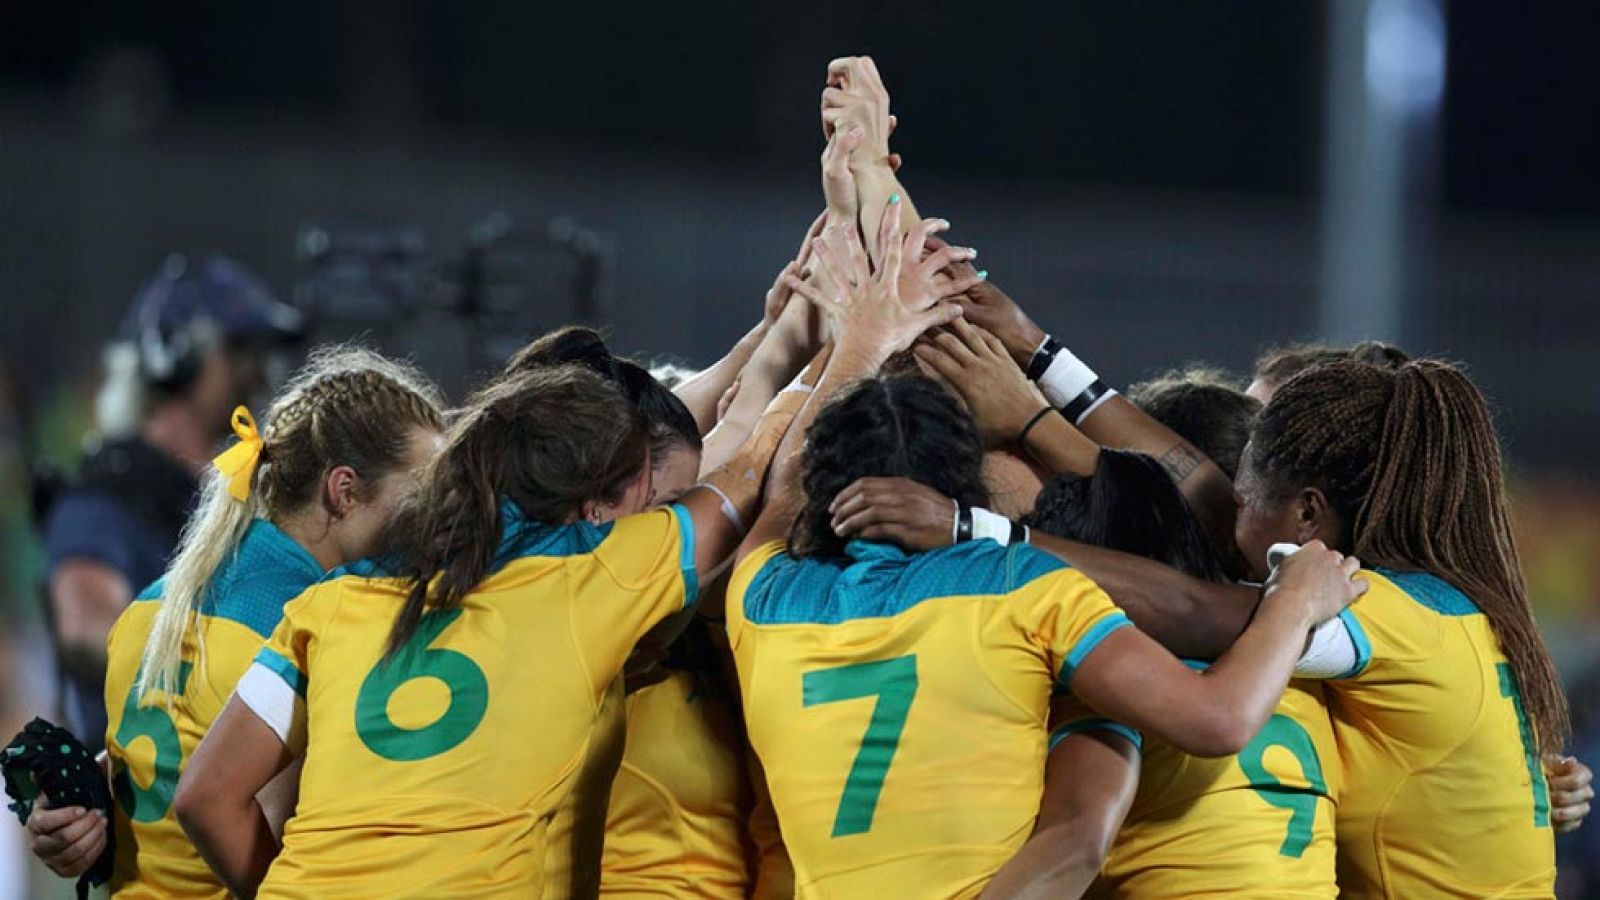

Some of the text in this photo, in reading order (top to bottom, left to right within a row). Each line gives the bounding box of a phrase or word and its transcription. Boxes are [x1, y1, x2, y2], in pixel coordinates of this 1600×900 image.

[113, 660, 192, 823] 5
[355, 608, 488, 761] 6
[802, 653, 918, 838] 7
[1238, 713, 1327, 858] 9
